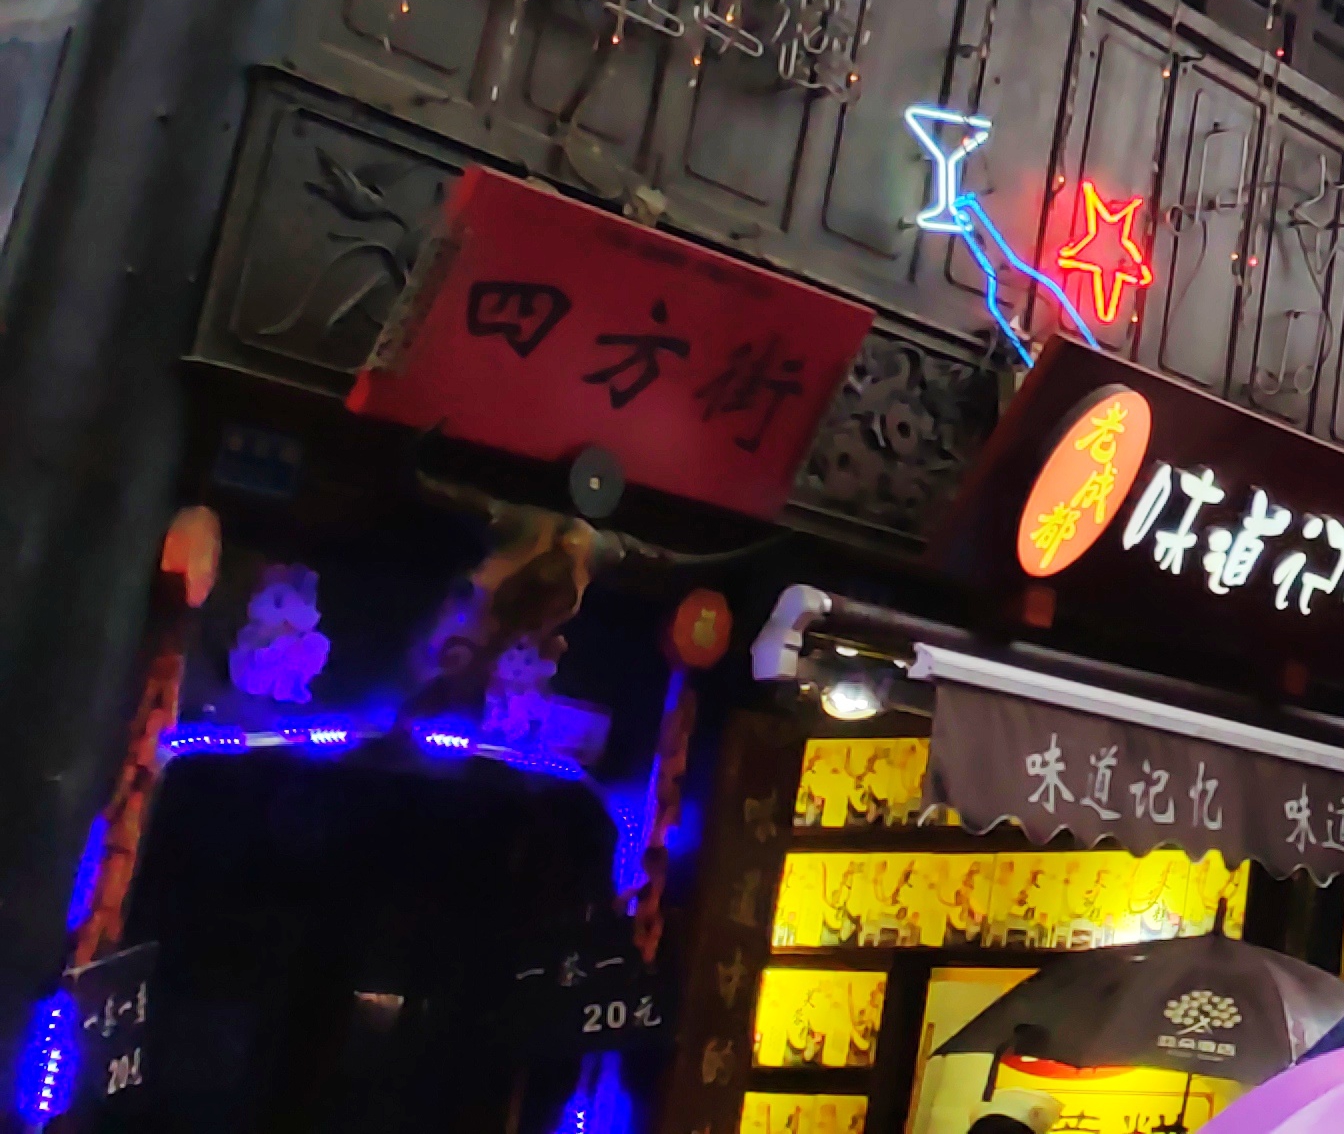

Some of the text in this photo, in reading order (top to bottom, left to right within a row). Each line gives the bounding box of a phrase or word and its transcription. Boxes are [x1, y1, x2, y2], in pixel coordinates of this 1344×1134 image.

[466, 280, 800, 454] 四方街
[1029, 401, 1129, 570] 老成都
[1025, 732, 1224, 831] 味道记忆
[582, 995, 662, 1033] 20元
